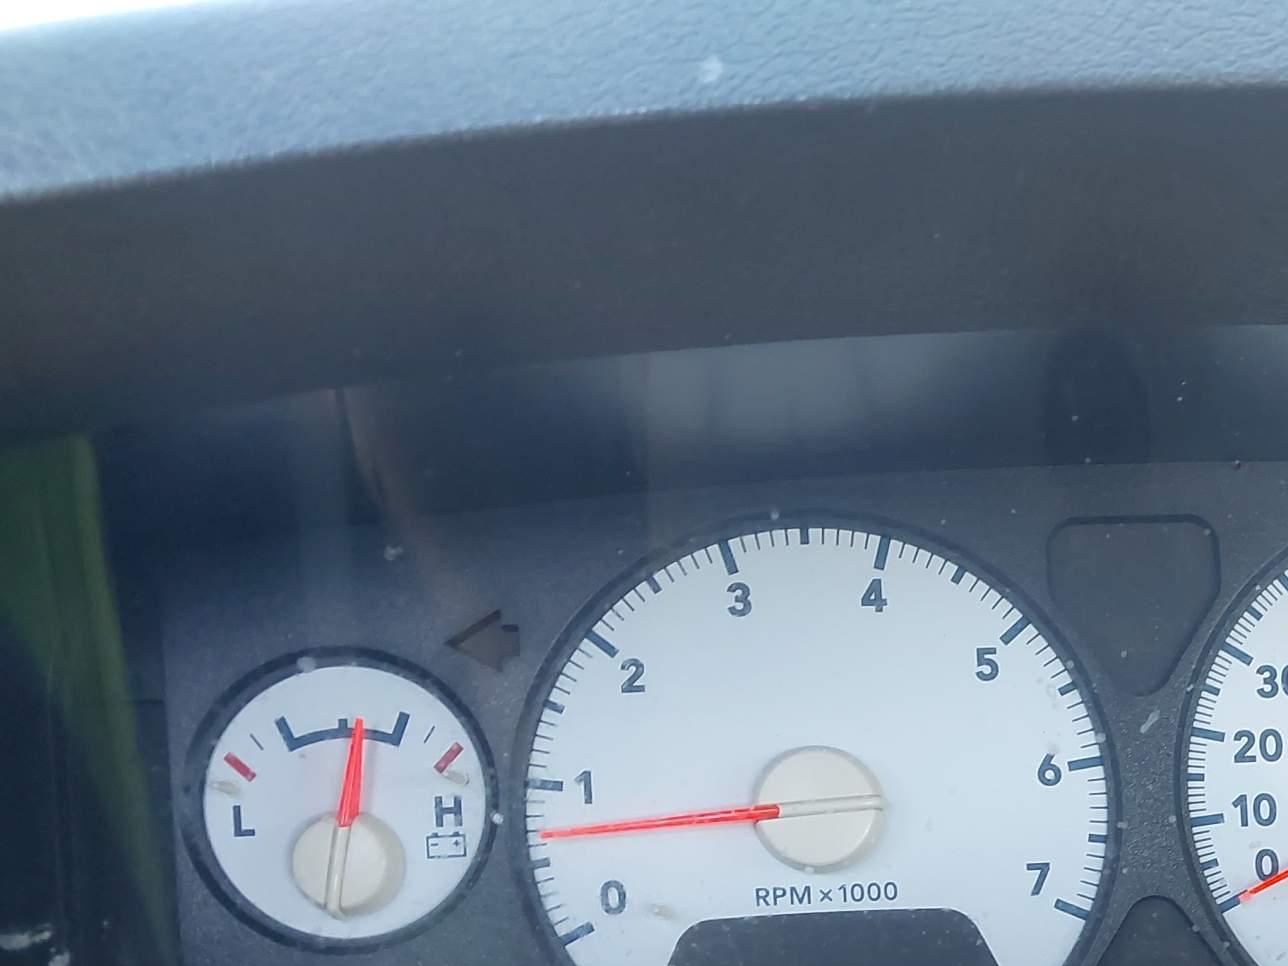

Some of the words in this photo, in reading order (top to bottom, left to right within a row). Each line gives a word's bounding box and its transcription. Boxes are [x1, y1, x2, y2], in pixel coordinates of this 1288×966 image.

[726, 582, 752, 618] 3
[860, 578, 888, 613] 4
[620, 658, 646, 694] 2
[975, 647, 1000, 682] 5
[1233, 728, 1283, 764] 20
[574, 770, 593, 805] 1
[1037, 753, 1062, 787] 6
[232, 804, 256, 838] L
[434, 795, 463, 828] H
[1231, 792, 1277, 828] 10
[1026, 862, 1051, 897] 7
[600, 880, 627, 915] 0
